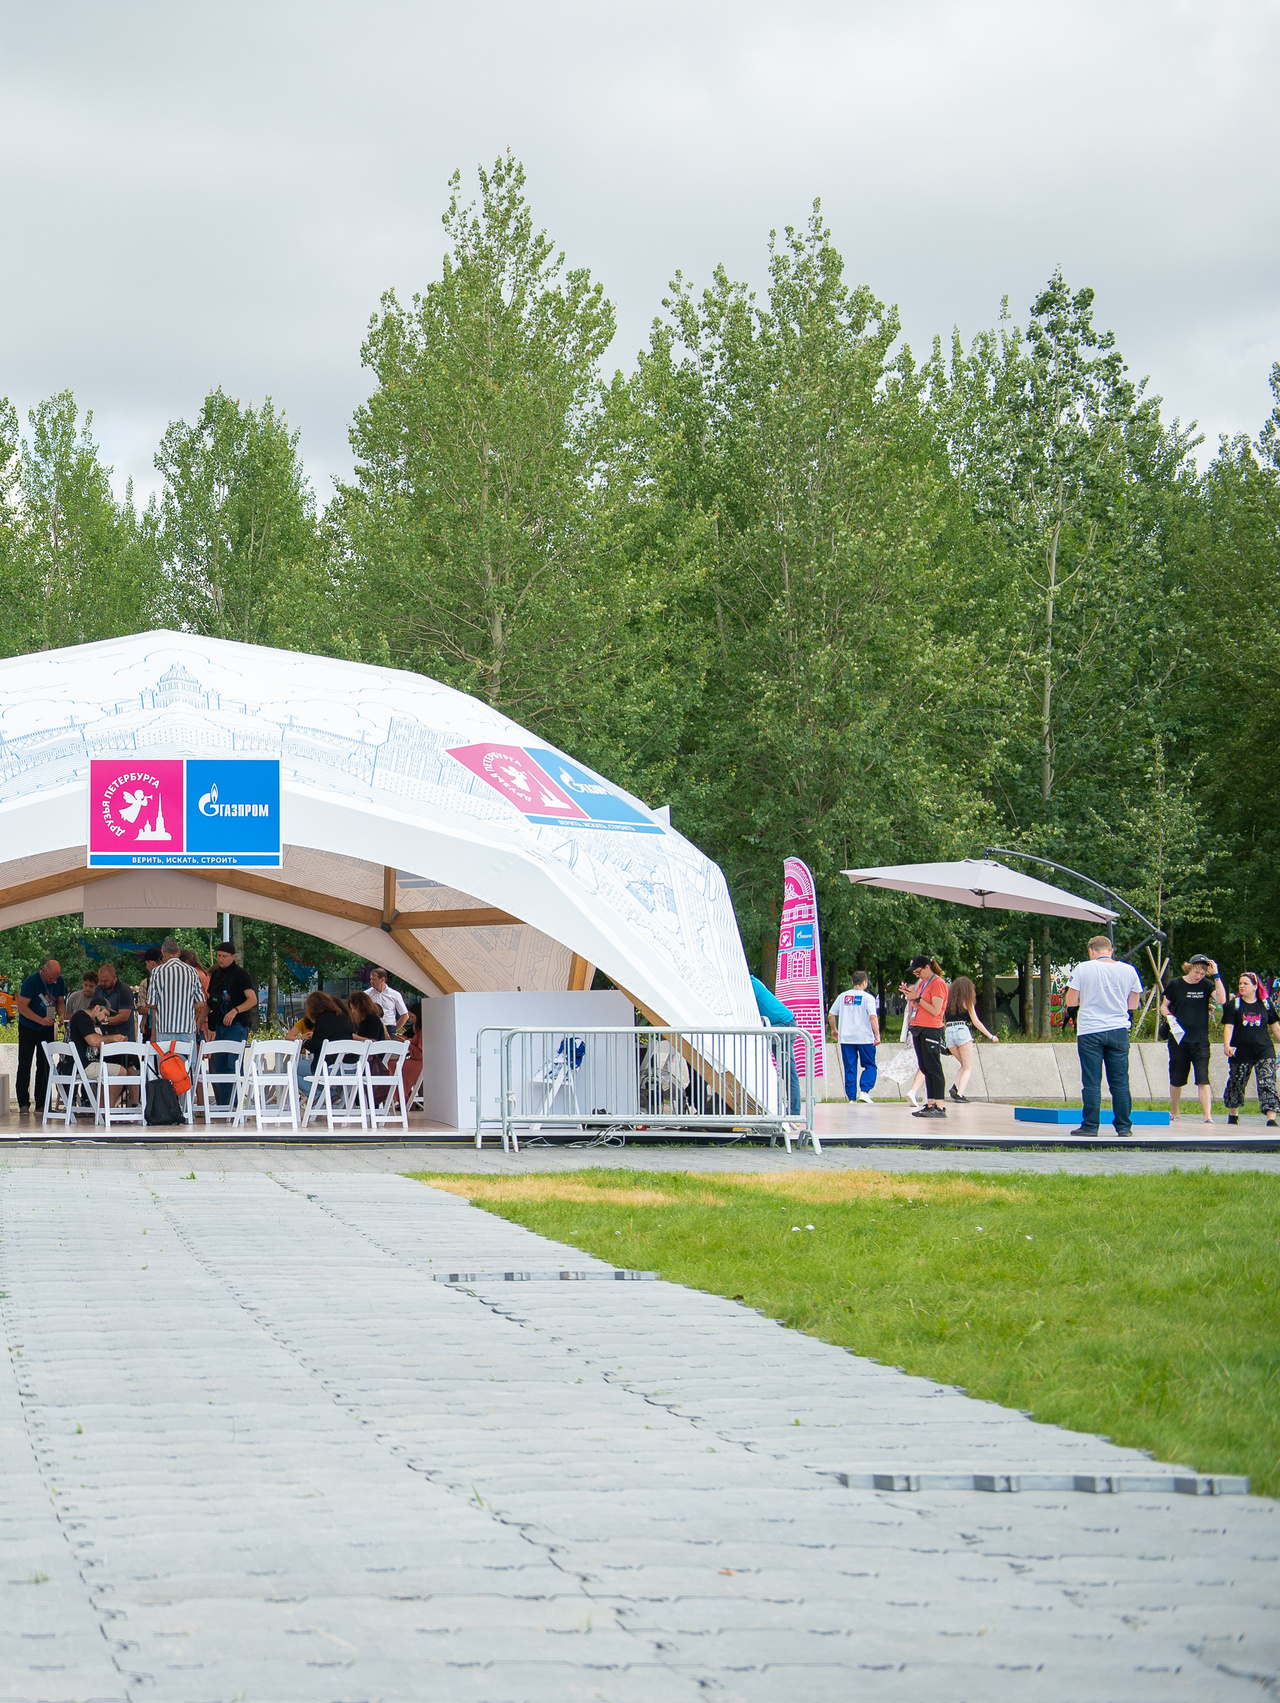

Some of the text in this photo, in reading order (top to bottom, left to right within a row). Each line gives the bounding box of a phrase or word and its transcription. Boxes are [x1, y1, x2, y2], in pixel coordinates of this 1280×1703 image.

[101, 772, 161, 838] ДРУЗЬЯ ПЕТЕРБУРГА
[219, 804, 269, 817] ГАЗПРОМ
[132, 856, 238, 865] ВЕРИТЬ, ИСКАТЬ, СТРОИТЬ
